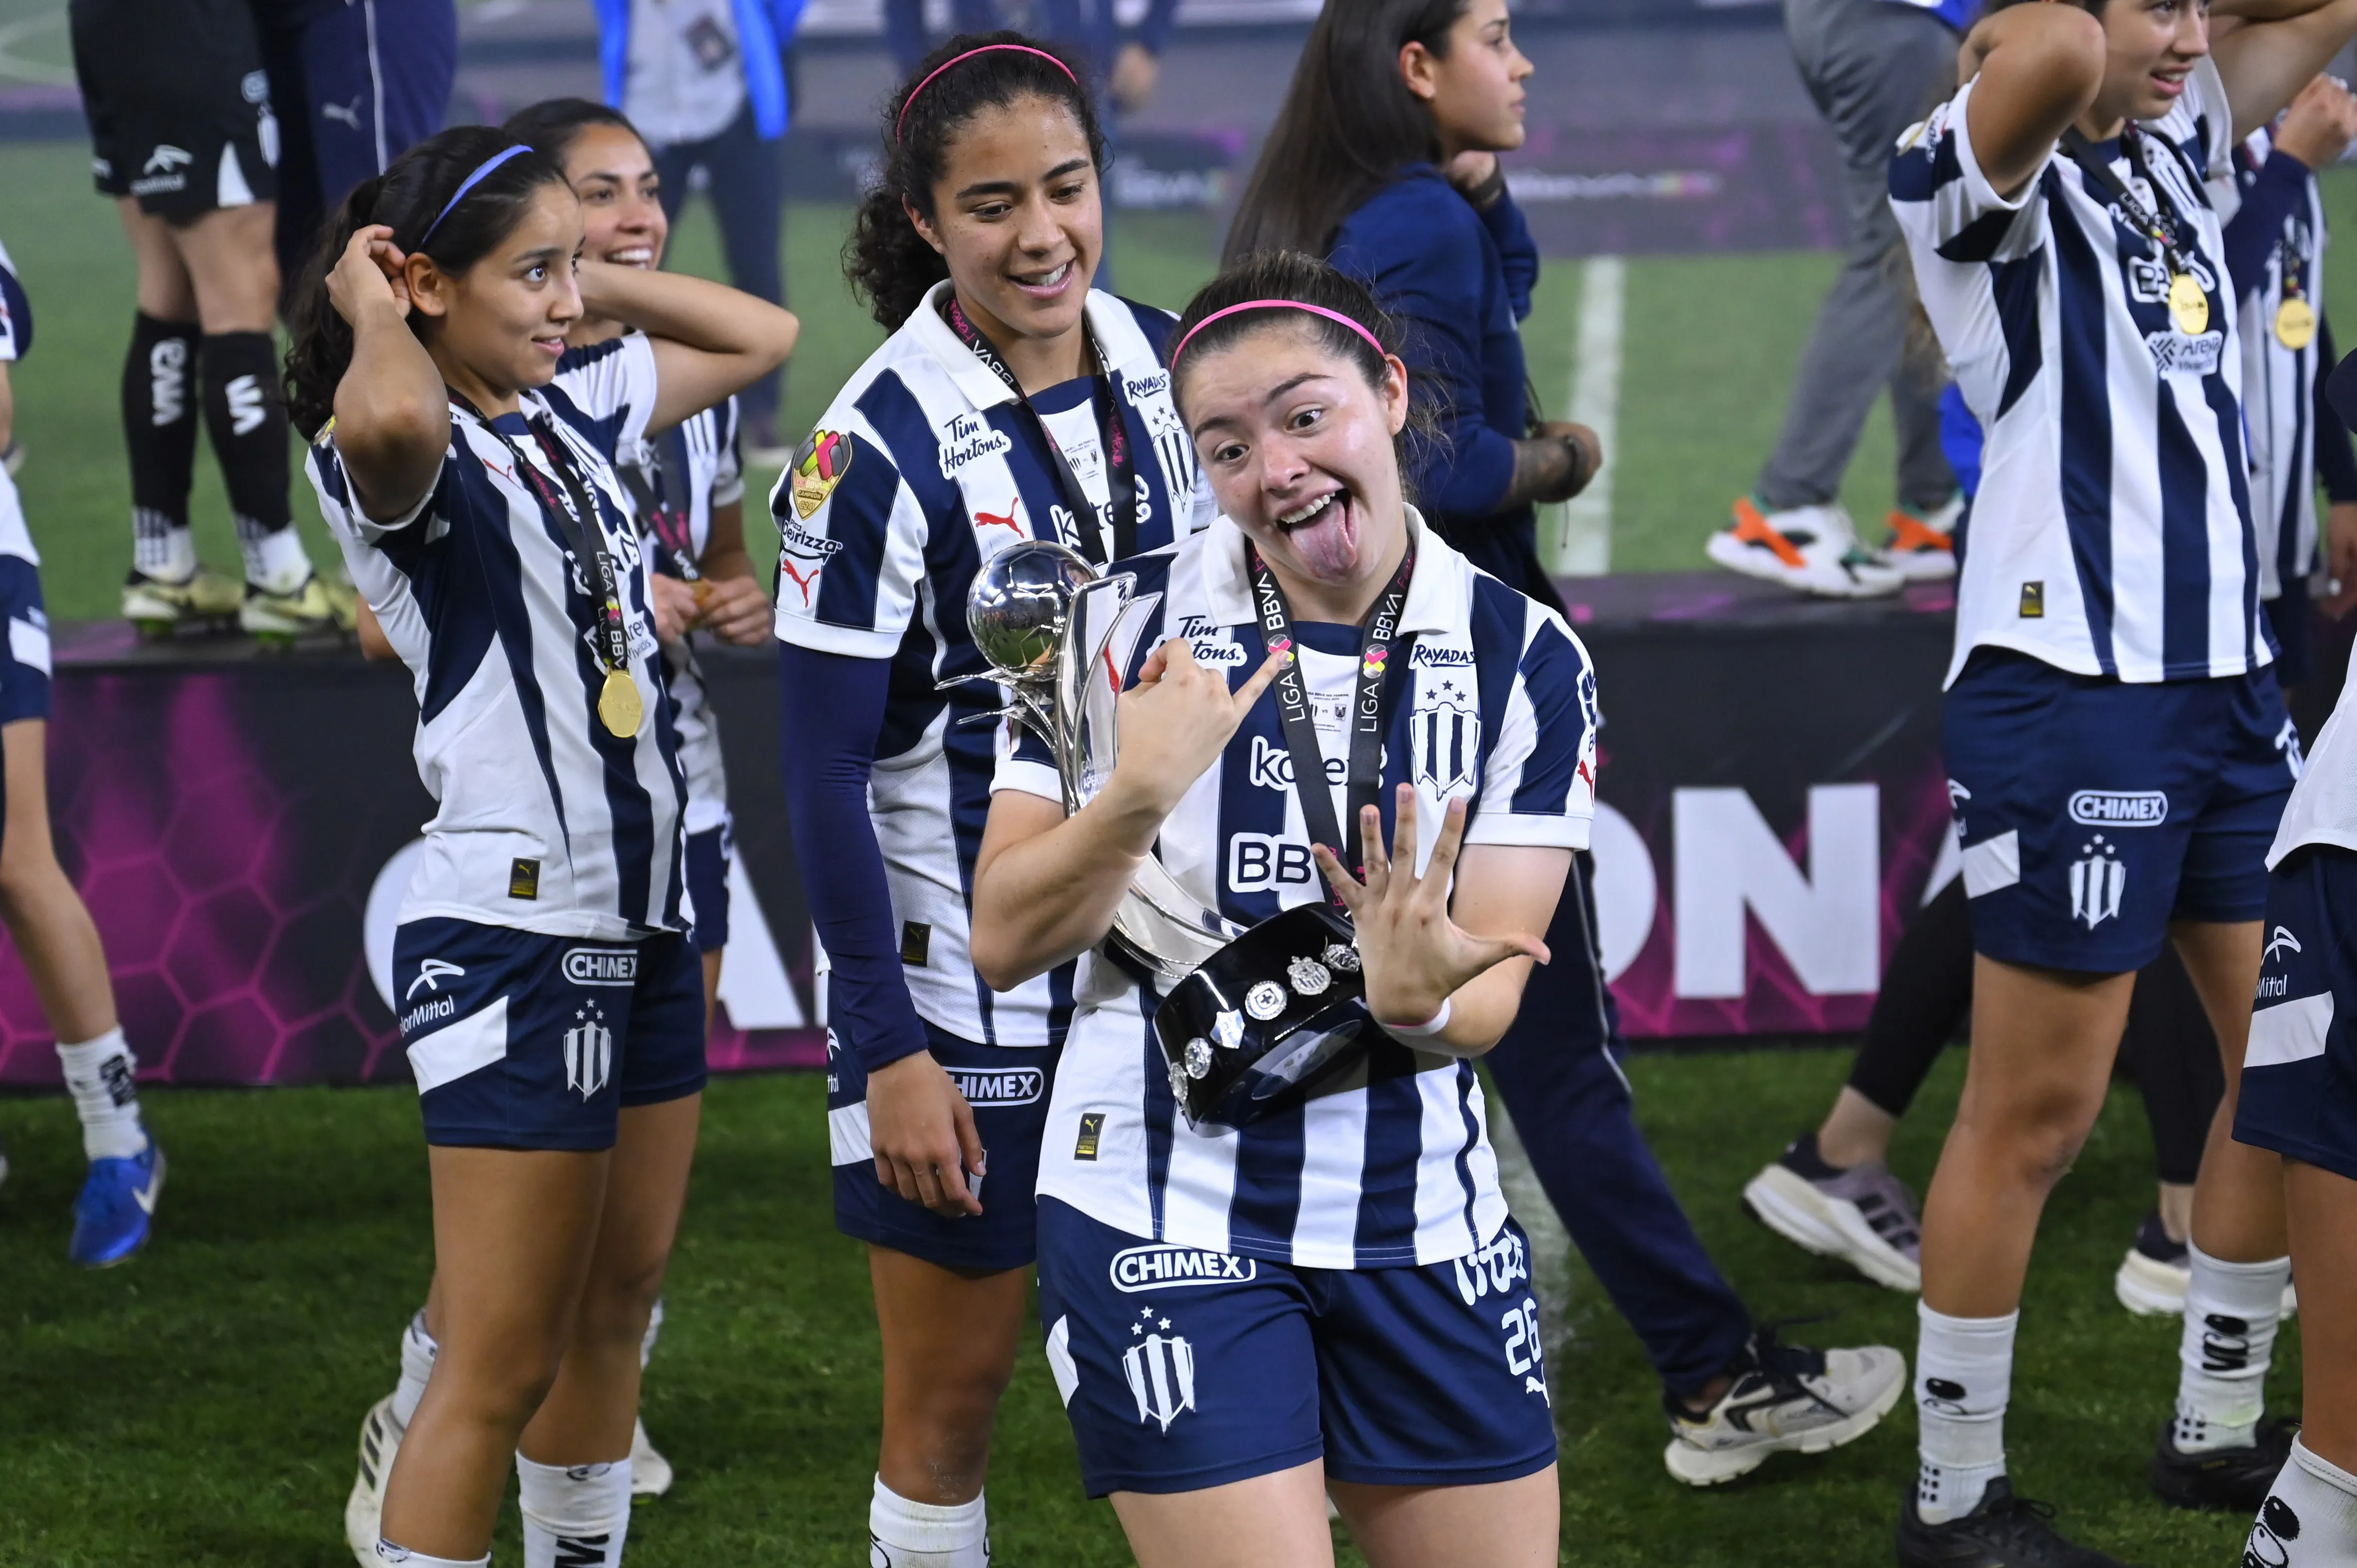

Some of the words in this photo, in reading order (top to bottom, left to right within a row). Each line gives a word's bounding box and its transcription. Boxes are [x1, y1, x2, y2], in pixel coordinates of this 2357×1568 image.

[1126, 373, 1167, 401] RAYADAS
[944, 414, 980, 442] Tim
[596, 550, 614, 592] LIGA
[1256, 572, 1285, 631] BBVA
[1372, 593, 1403, 641] BBVA
[1178, 615, 1218, 638] Tim
[610, 630, 624, 668] BBV
[1413, 644, 1475, 667] RAYADAS
[1279, 671, 1306, 722] LIGA
[1359, 682, 1379, 732] LIGA
[2077, 795, 2162, 820] CHIMEX
[949, 1074, 1036, 1098] HIMEX
[1119, 1252, 1244, 1283] CHIMEX
[1501, 1297, 1542, 1376] 26
